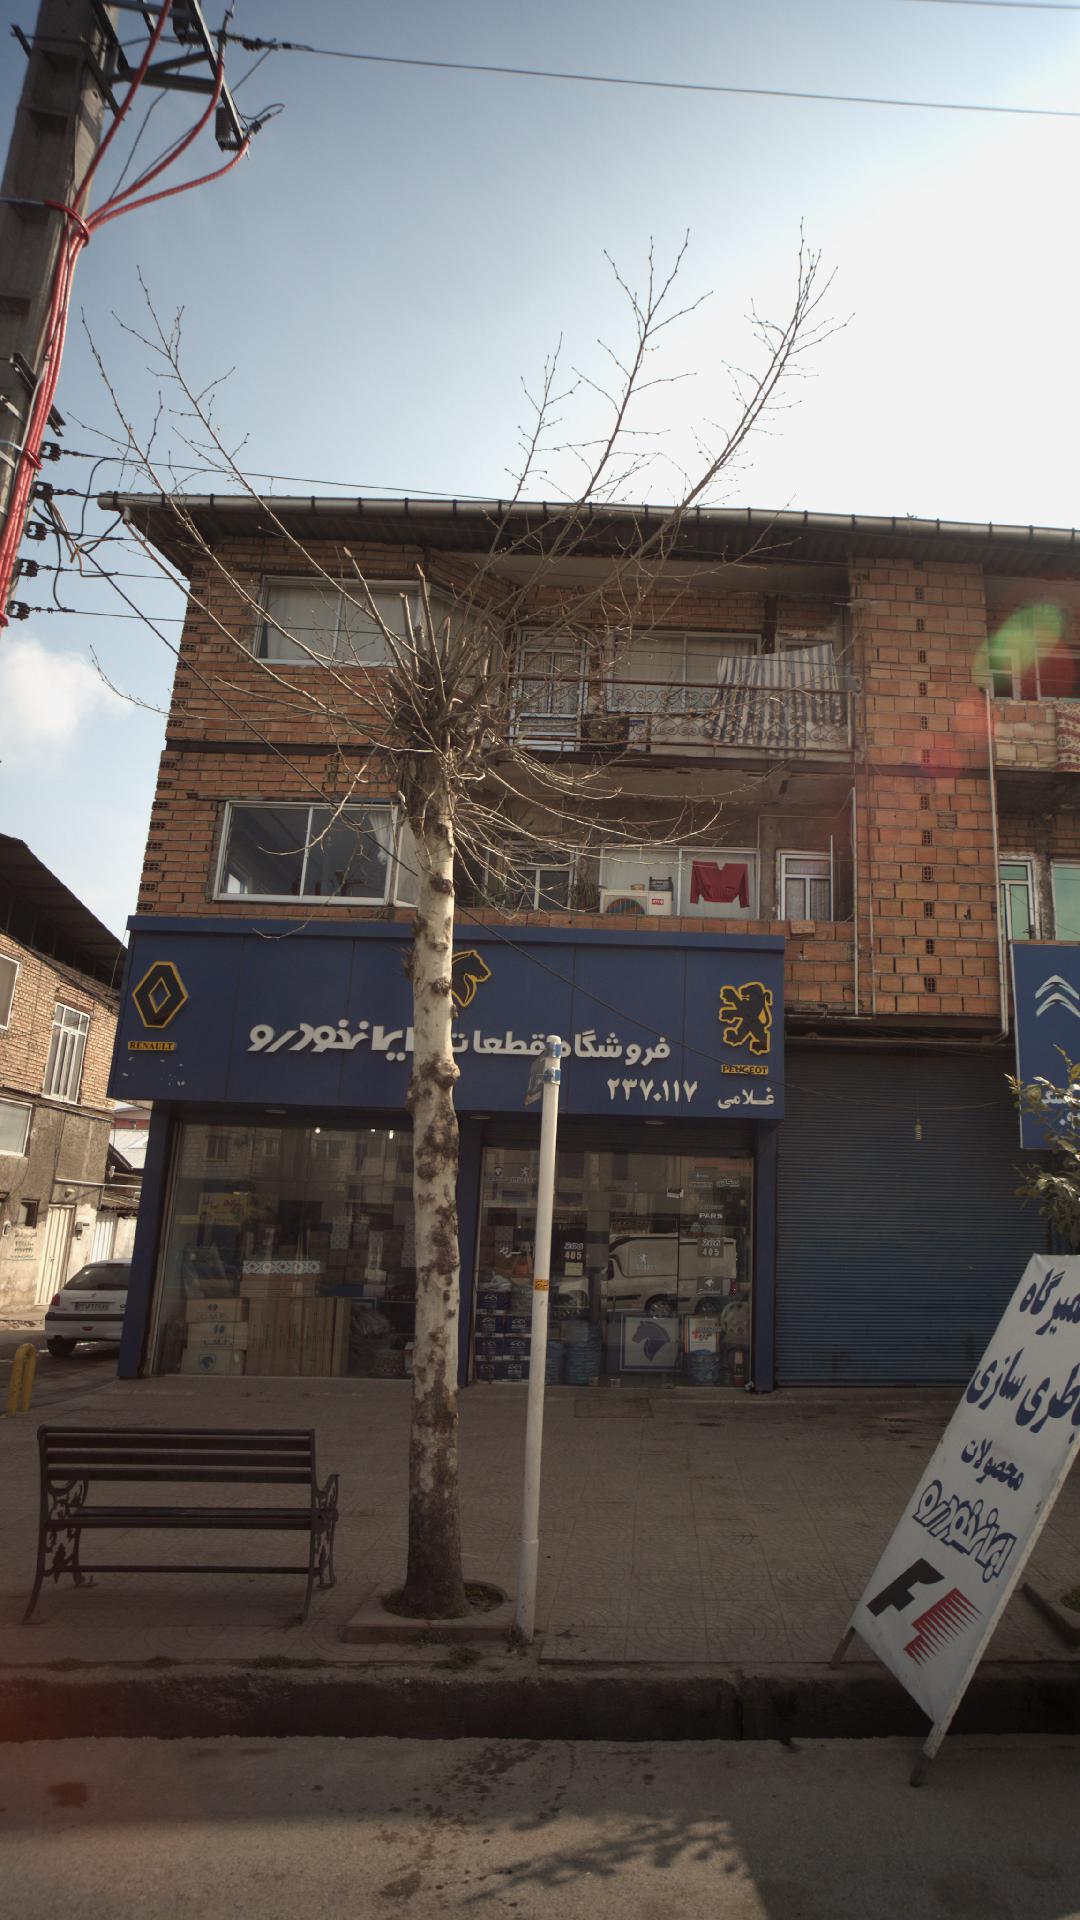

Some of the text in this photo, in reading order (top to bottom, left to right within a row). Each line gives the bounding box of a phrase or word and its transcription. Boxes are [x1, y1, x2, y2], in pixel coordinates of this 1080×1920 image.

[128, 1041, 175, 1050] RENAULT
[722, 1065, 768, 1074] PEUGEOT
[717, 1087, 775, 1110] غلامی
[564, 1250, 582, 1260] 405
[966, 1347, 1026, 1410] سازی
